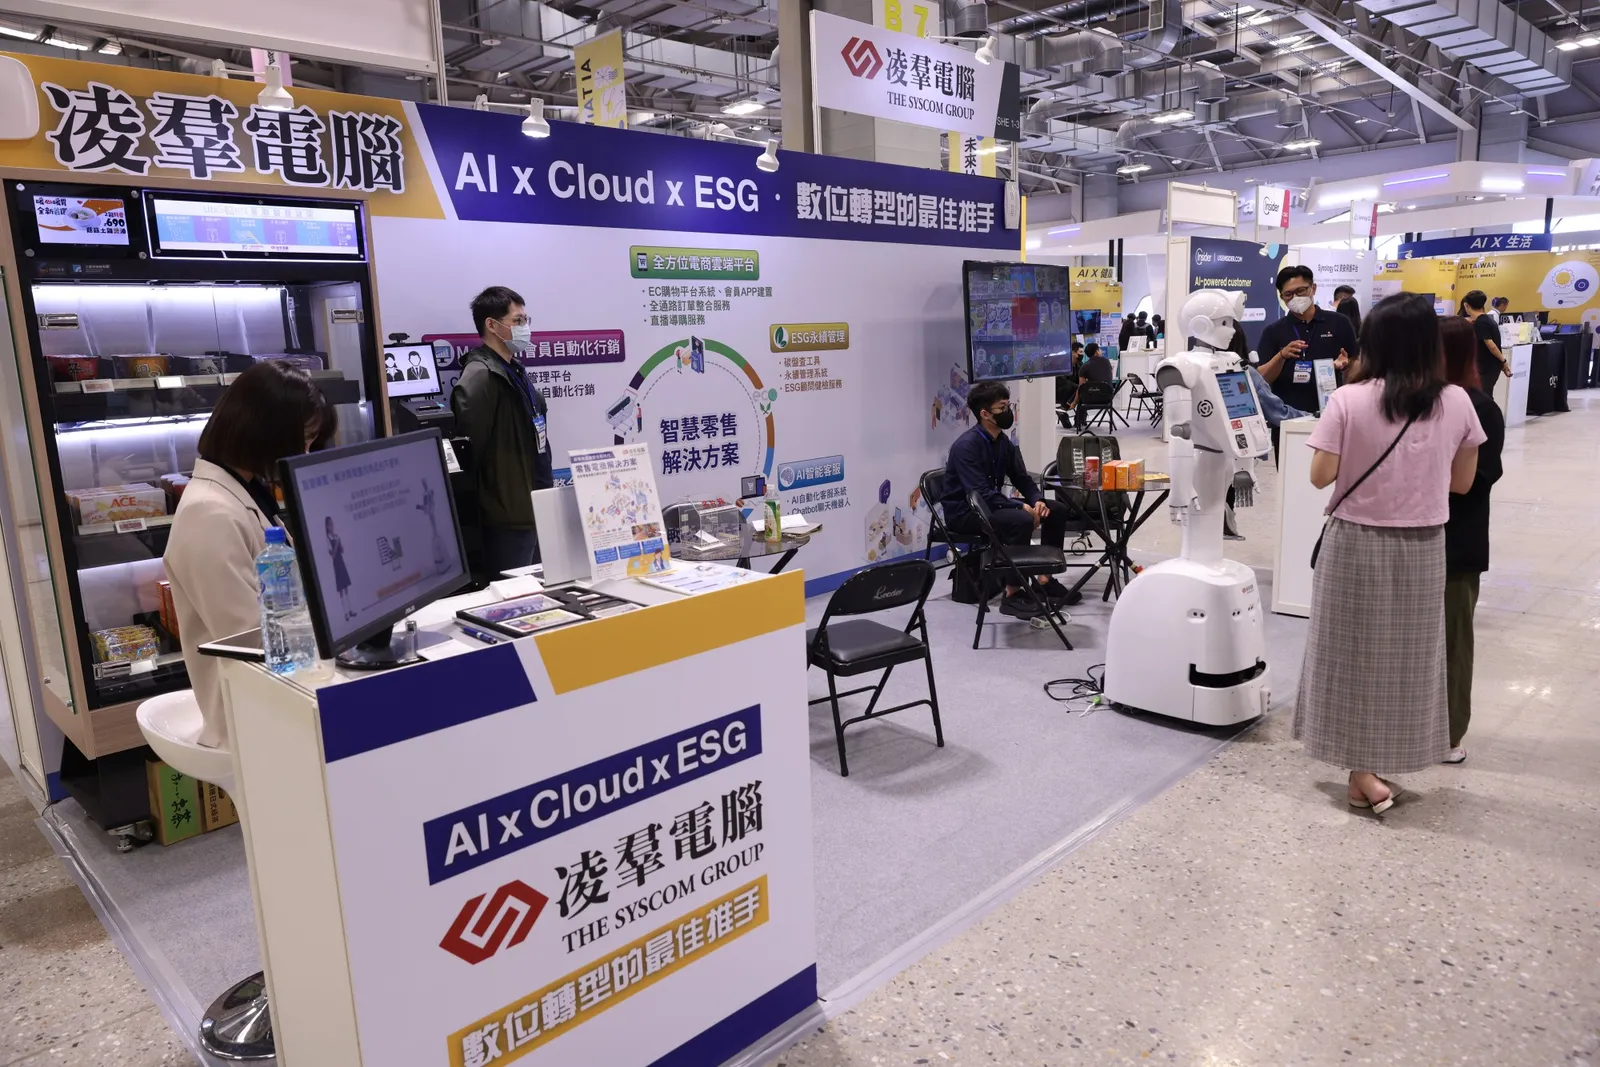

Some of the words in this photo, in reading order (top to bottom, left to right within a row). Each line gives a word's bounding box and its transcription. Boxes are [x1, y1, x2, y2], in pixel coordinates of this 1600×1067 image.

[887, 91, 907, 107] THE
[908, 95, 944, 114] SYSCOM
[945, 104, 975, 120] GROUP
[455, 151, 498, 192] AI
[512, 164, 534, 195] x
[548, 160, 655, 204] Cloud
[665, 181, 686, 208] x
[694, 175, 759, 212] ESG
[797, 182, 995, 235] 數位轉型的最佳推手
[1470, 237, 1489, 249] AI
[1491, 236, 1504, 248] X
[1505, 235, 1533, 249] 生活
[653, 254, 755, 272] 全方位電商雲端平台
[1077, 269, 1089, 278] AI
[1091, 269, 1099, 278] X
[1194, 276, 1228, 289] AI-powered
[1228, 277, 1252, 287] customer
[649, 300, 731, 312] 全通路訂單整合服務
[650, 314, 706, 326] 直播導購服務
[791, 330, 846, 344] ESG永續管理
[537, 383, 595, 399] 自動化行銷
[660, 412, 738, 444] 智慧零售
[661, 442, 740, 475] 解決方案
[796, 462, 841, 481] AI智能客服
[110, 496, 136, 508] ACE
[791, 486, 847, 504] AI自動化客服系統
[444, 813, 490, 866] AI
[499, 809, 522, 845] x
[530, 756, 644, 830] Cloud
[652, 754, 671, 785] x
[677, 720, 747, 774] ESG
[562, 916, 610, 955] THE
[615, 873, 696, 929] SYSCOM
[701, 842, 764, 886] GROUP
[462, 885, 761, 1067] 數位轉型的最佳推手
